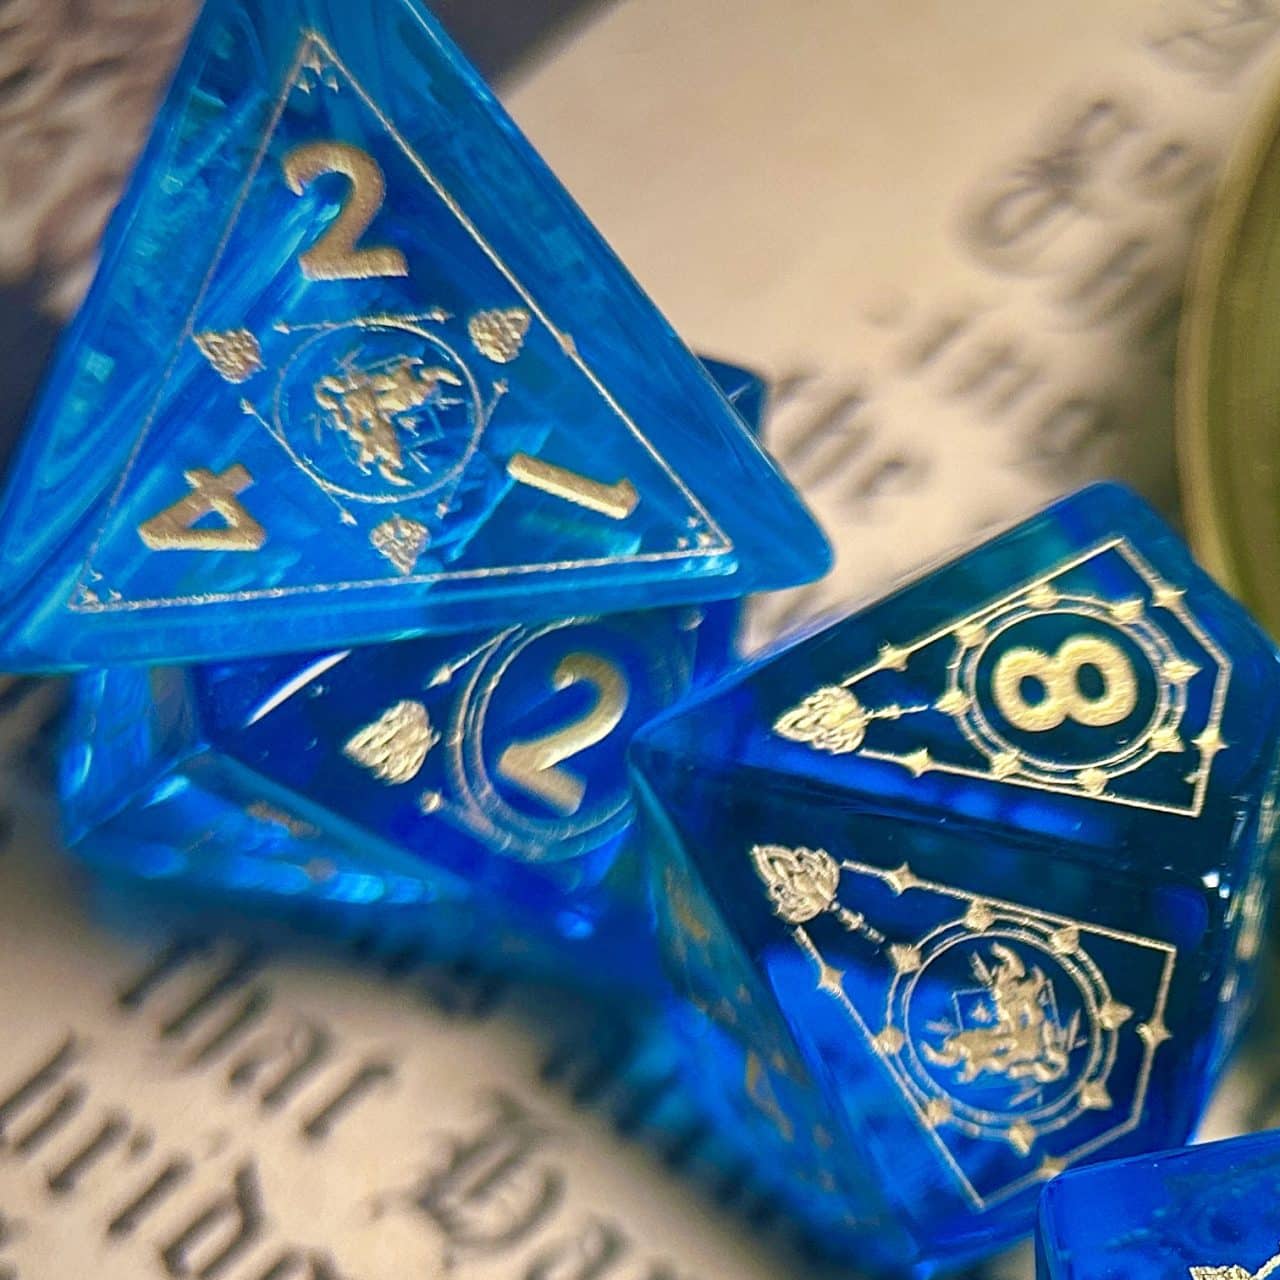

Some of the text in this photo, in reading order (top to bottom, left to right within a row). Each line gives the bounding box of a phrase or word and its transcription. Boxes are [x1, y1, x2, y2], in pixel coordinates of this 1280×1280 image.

[281, 141, 409, 281] 2
[138, 463, 268, 552] 4
[506, 452, 640, 521] 1
[990, 634, 1139, 733] 8
[500, 651, 630, 816] 2
